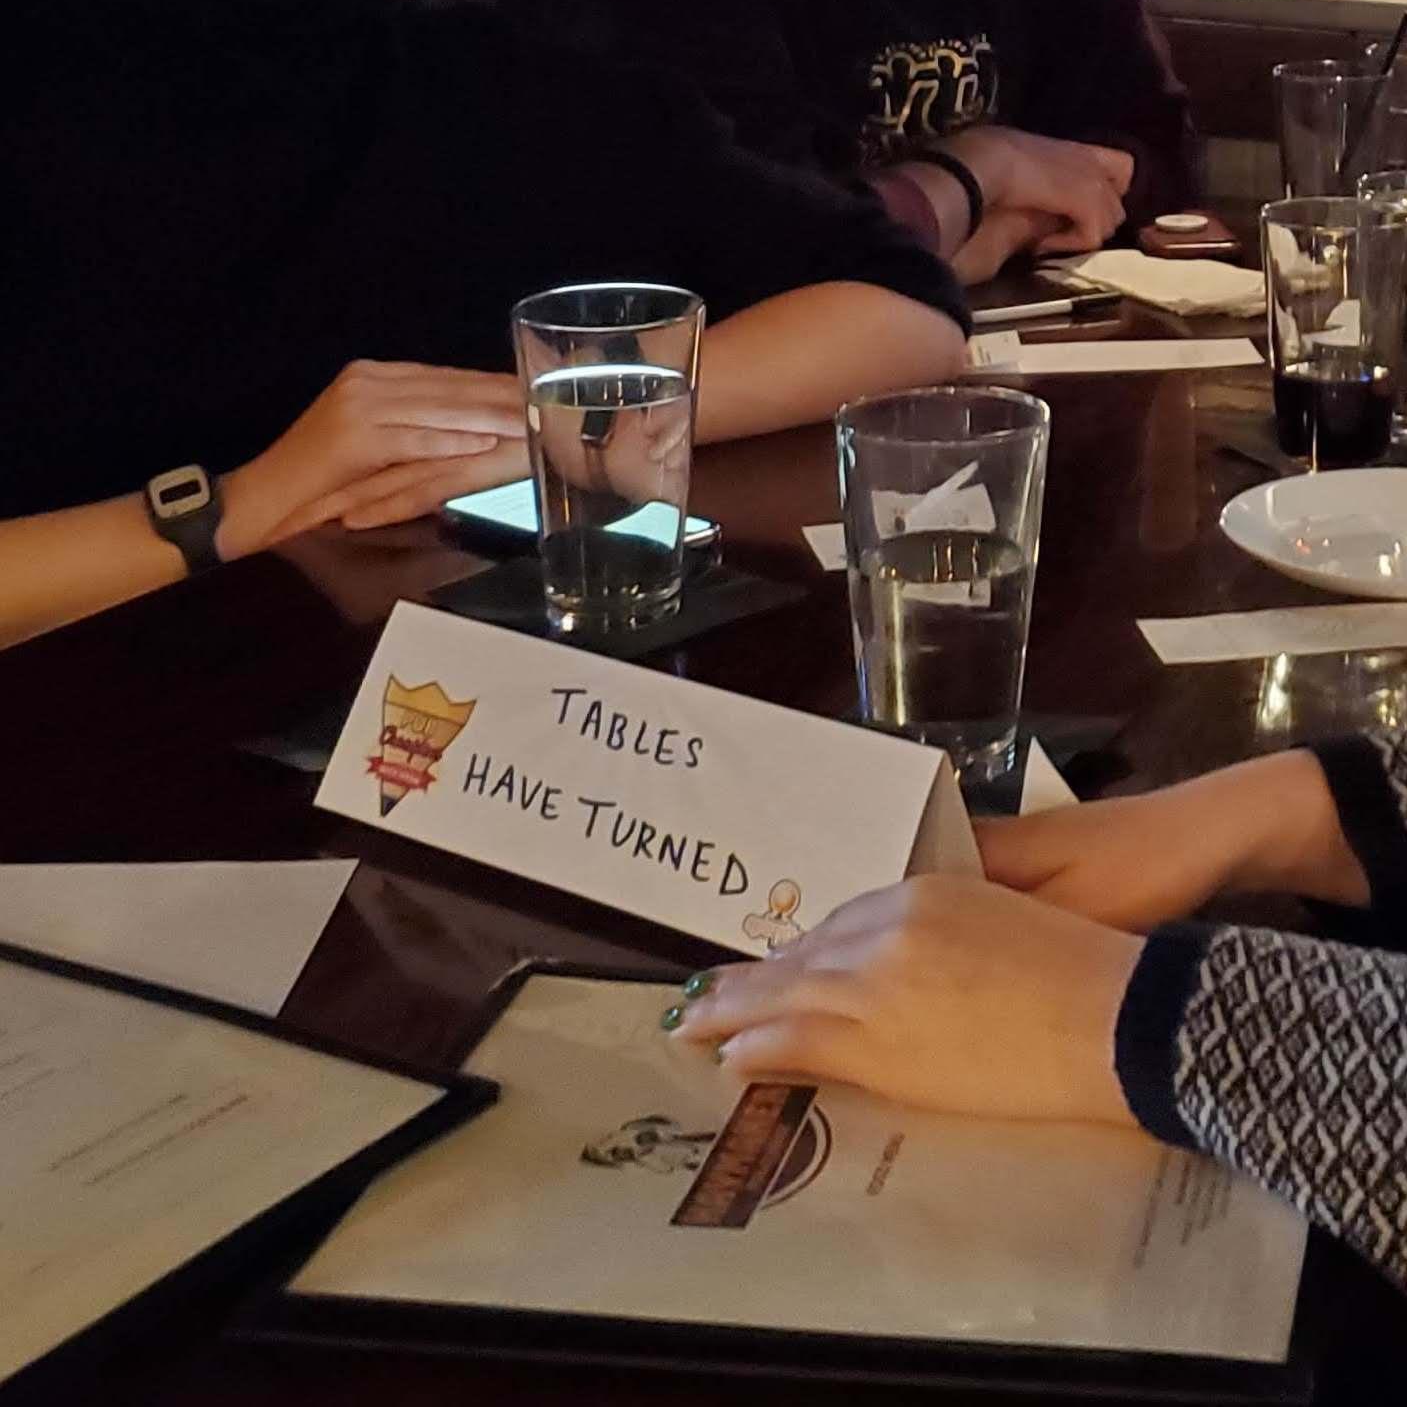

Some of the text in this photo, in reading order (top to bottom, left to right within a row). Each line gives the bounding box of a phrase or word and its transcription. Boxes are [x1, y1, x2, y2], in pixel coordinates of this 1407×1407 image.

[550, 687, 704, 769] TABLES
[461, 752, 750, 897] HAVE TURNED
